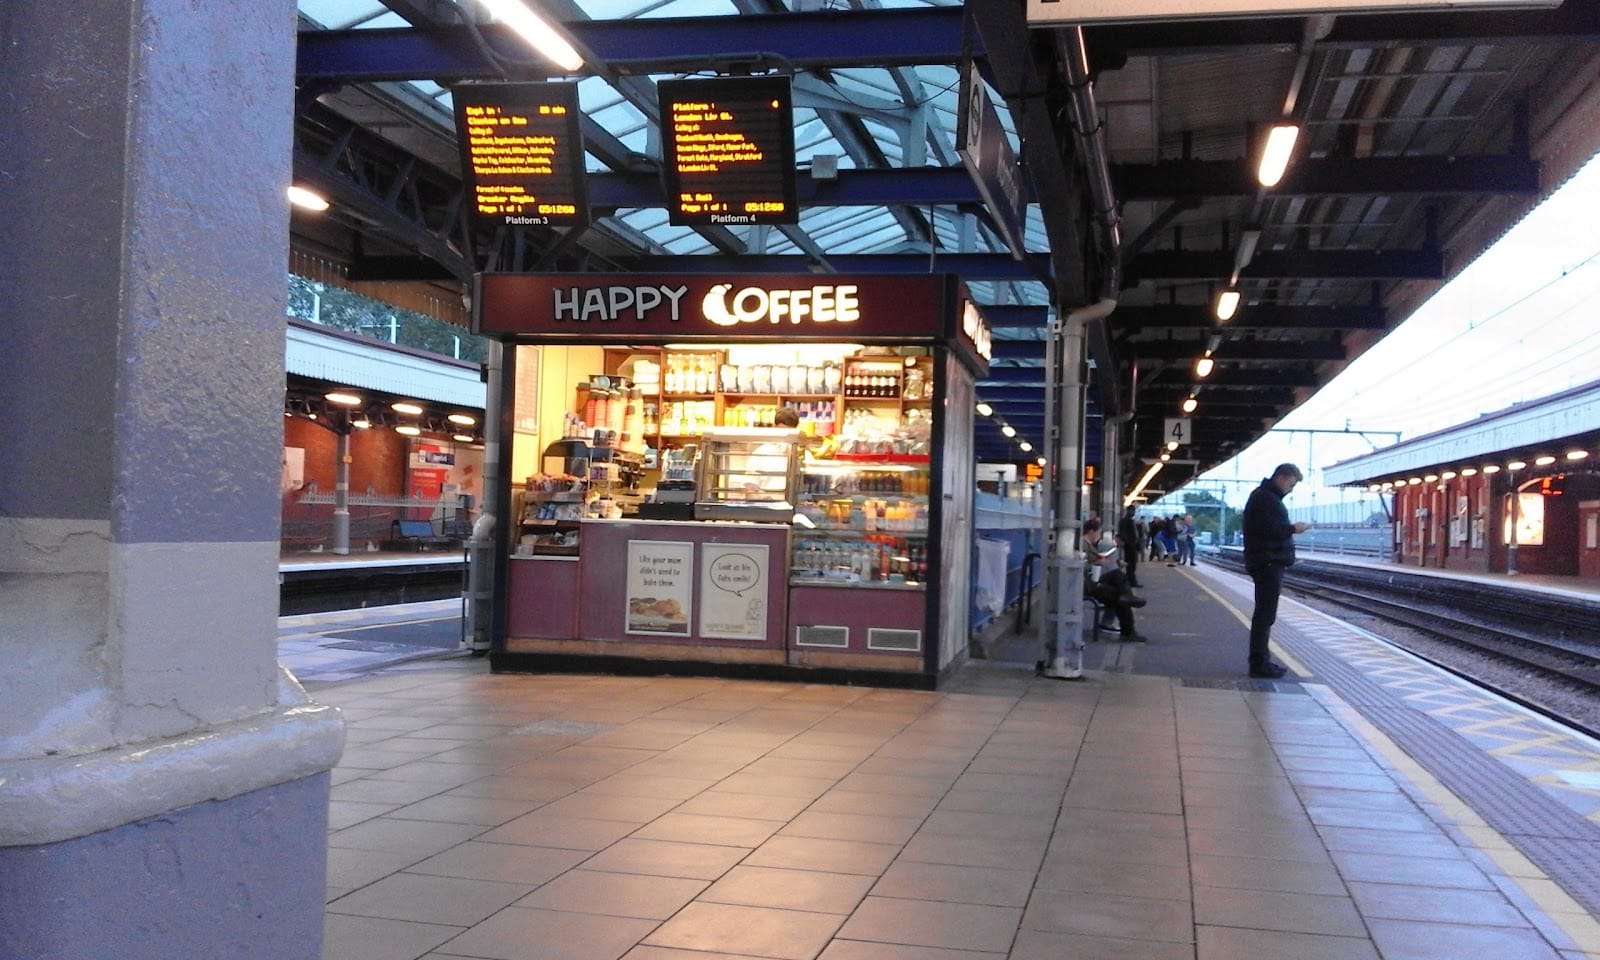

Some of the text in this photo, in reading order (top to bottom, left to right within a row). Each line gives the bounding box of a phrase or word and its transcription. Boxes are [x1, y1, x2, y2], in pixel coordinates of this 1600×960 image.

[505, 215, 549, 225] Platform 3
[710, 214, 756, 223] Platform 4
[552, 284, 860, 327] HAPPY COFFEE
[1171, 422, 1184, 441] 4
